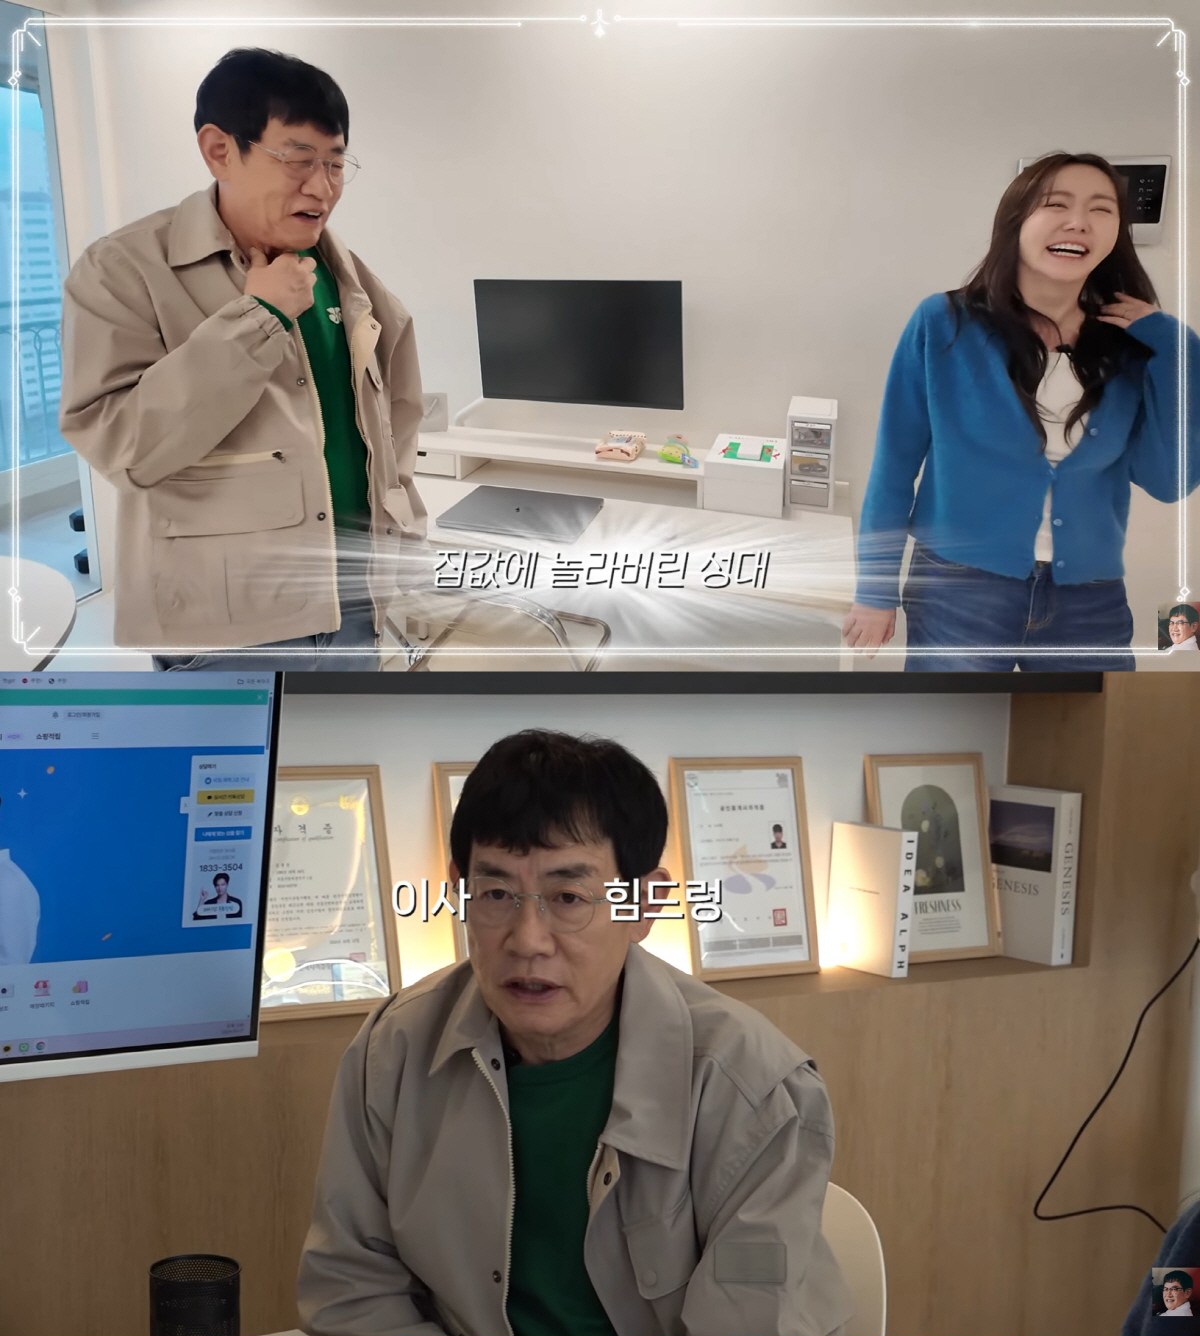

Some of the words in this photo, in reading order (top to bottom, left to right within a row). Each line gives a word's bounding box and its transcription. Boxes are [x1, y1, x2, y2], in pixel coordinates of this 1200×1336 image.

[199, 863, 243, 872] 1833-3504
[902, 839, 915, 893] IDEA
[996, 877, 1039, 896] ENESIS
[1060, 842, 1074, 916] GENESIS
[896, 912, 909, 969] ALPH
